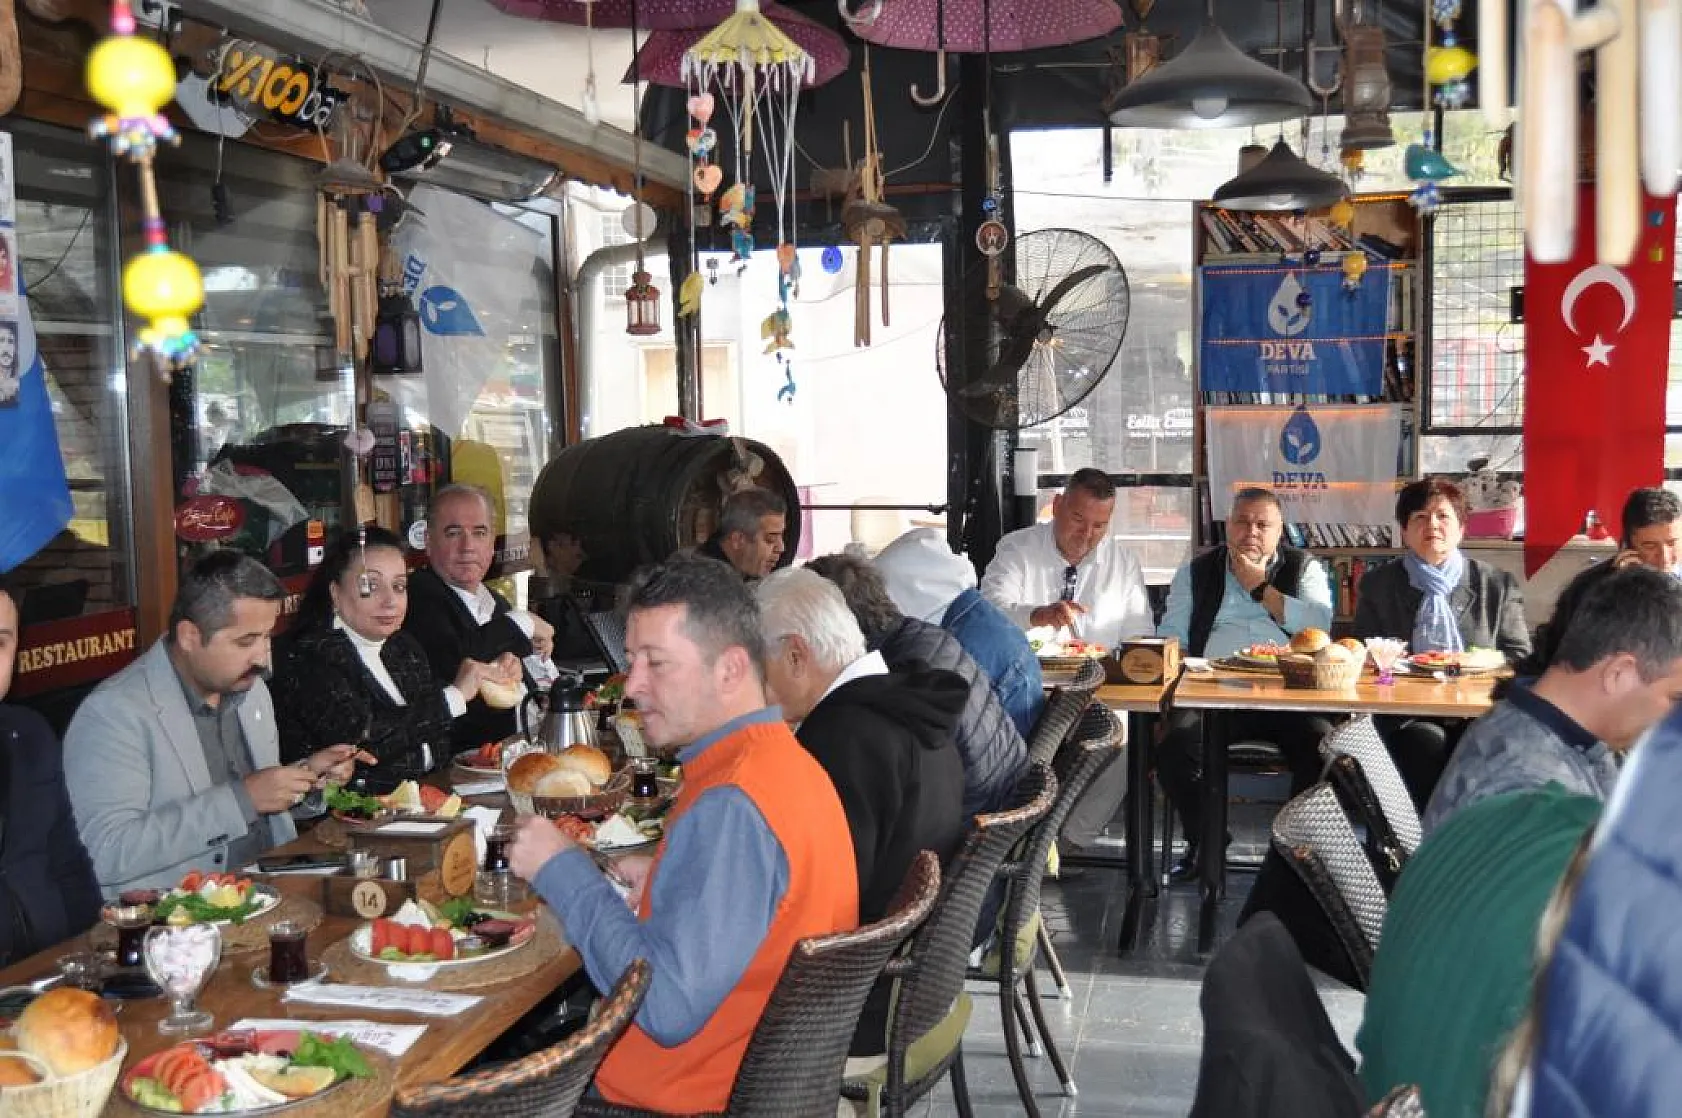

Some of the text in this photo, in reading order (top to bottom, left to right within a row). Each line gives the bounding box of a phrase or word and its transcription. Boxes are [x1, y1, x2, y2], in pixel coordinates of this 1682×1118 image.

[1259, 342, 1317, 360] DEVA
[1272, 471, 1328, 489] DEVA
[18, 628, 136, 673] RESTAURANT
[361, 891, 379, 908] 14
